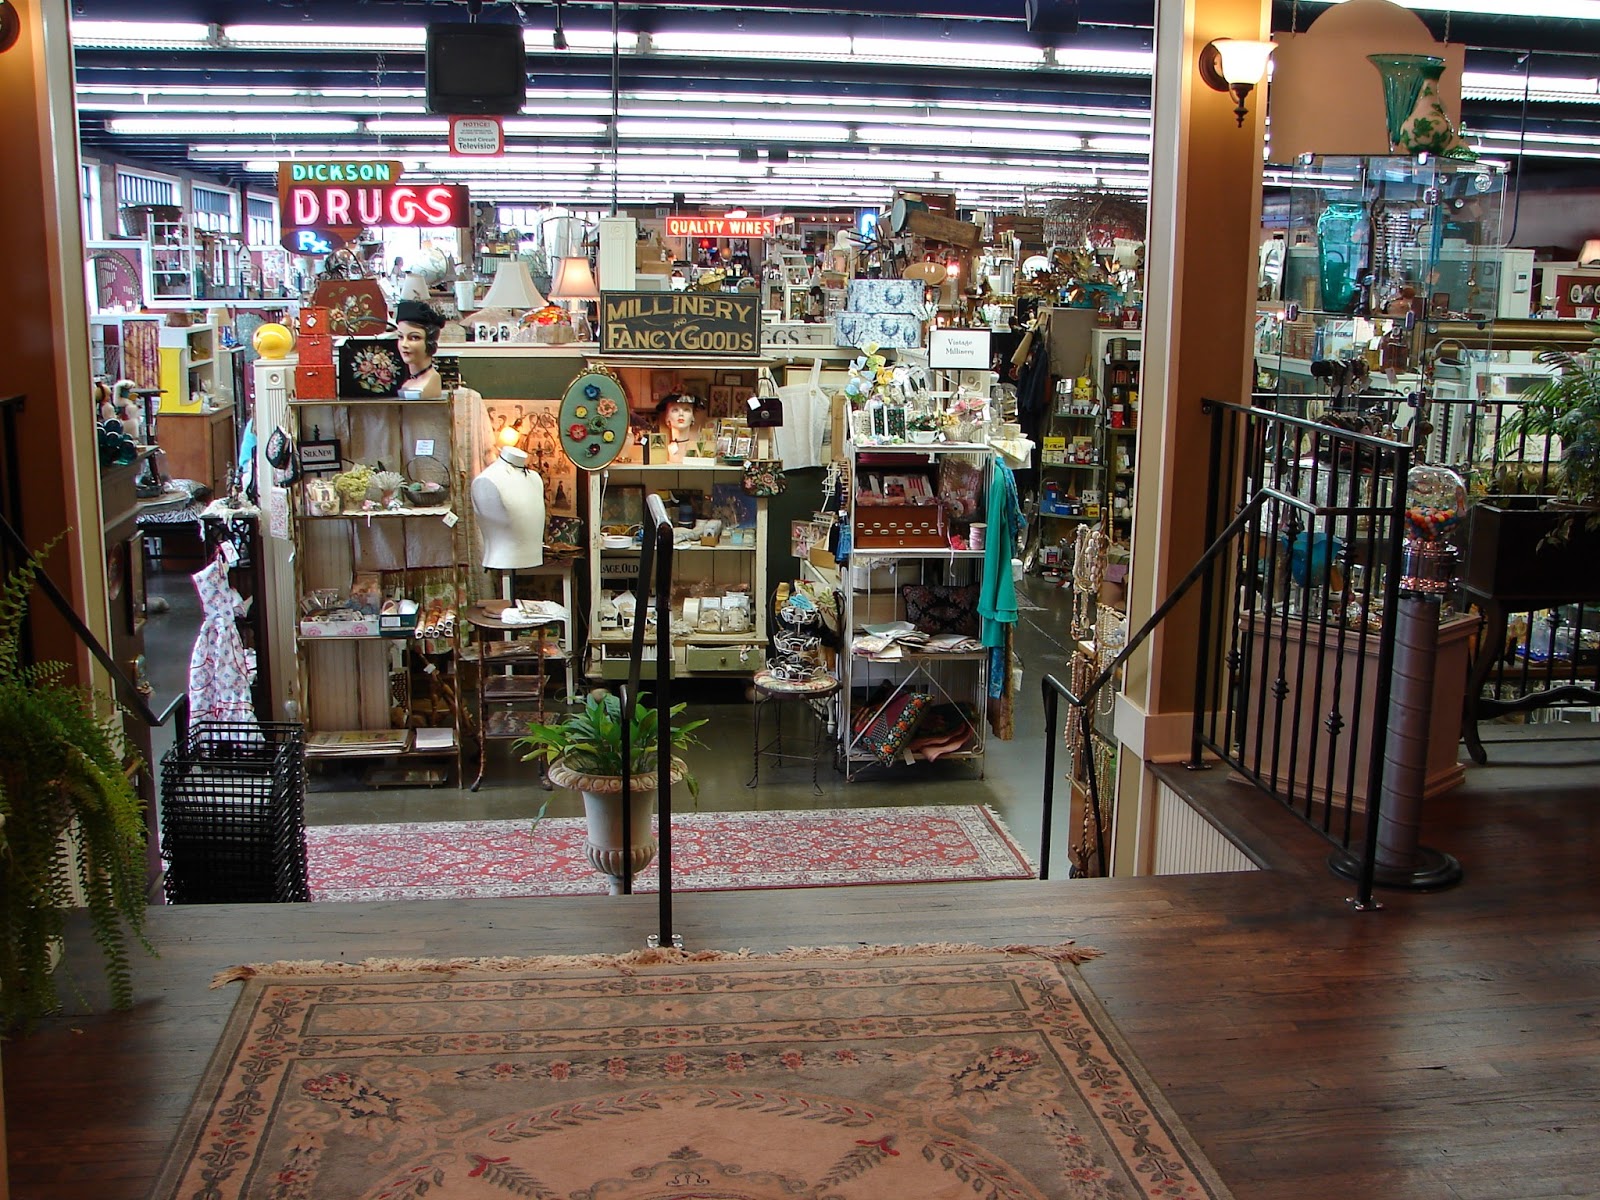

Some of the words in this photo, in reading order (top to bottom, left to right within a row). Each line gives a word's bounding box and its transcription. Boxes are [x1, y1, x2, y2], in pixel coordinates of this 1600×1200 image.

[292, 164, 390, 181] DICKSON
[293, 188, 452, 225] DRUGS
[670, 220, 724, 235] QUALITY
[729, 221, 771, 235] WINES
[607, 295, 752, 323] MILLINERY
[673, 318, 687, 328] AND
[607, 323, 684, 349] FANCY
[680, 325, 753, 351] GOODS
[947, 338, 973, 346] Vintage
[622, 563, 639, 574] OLD
